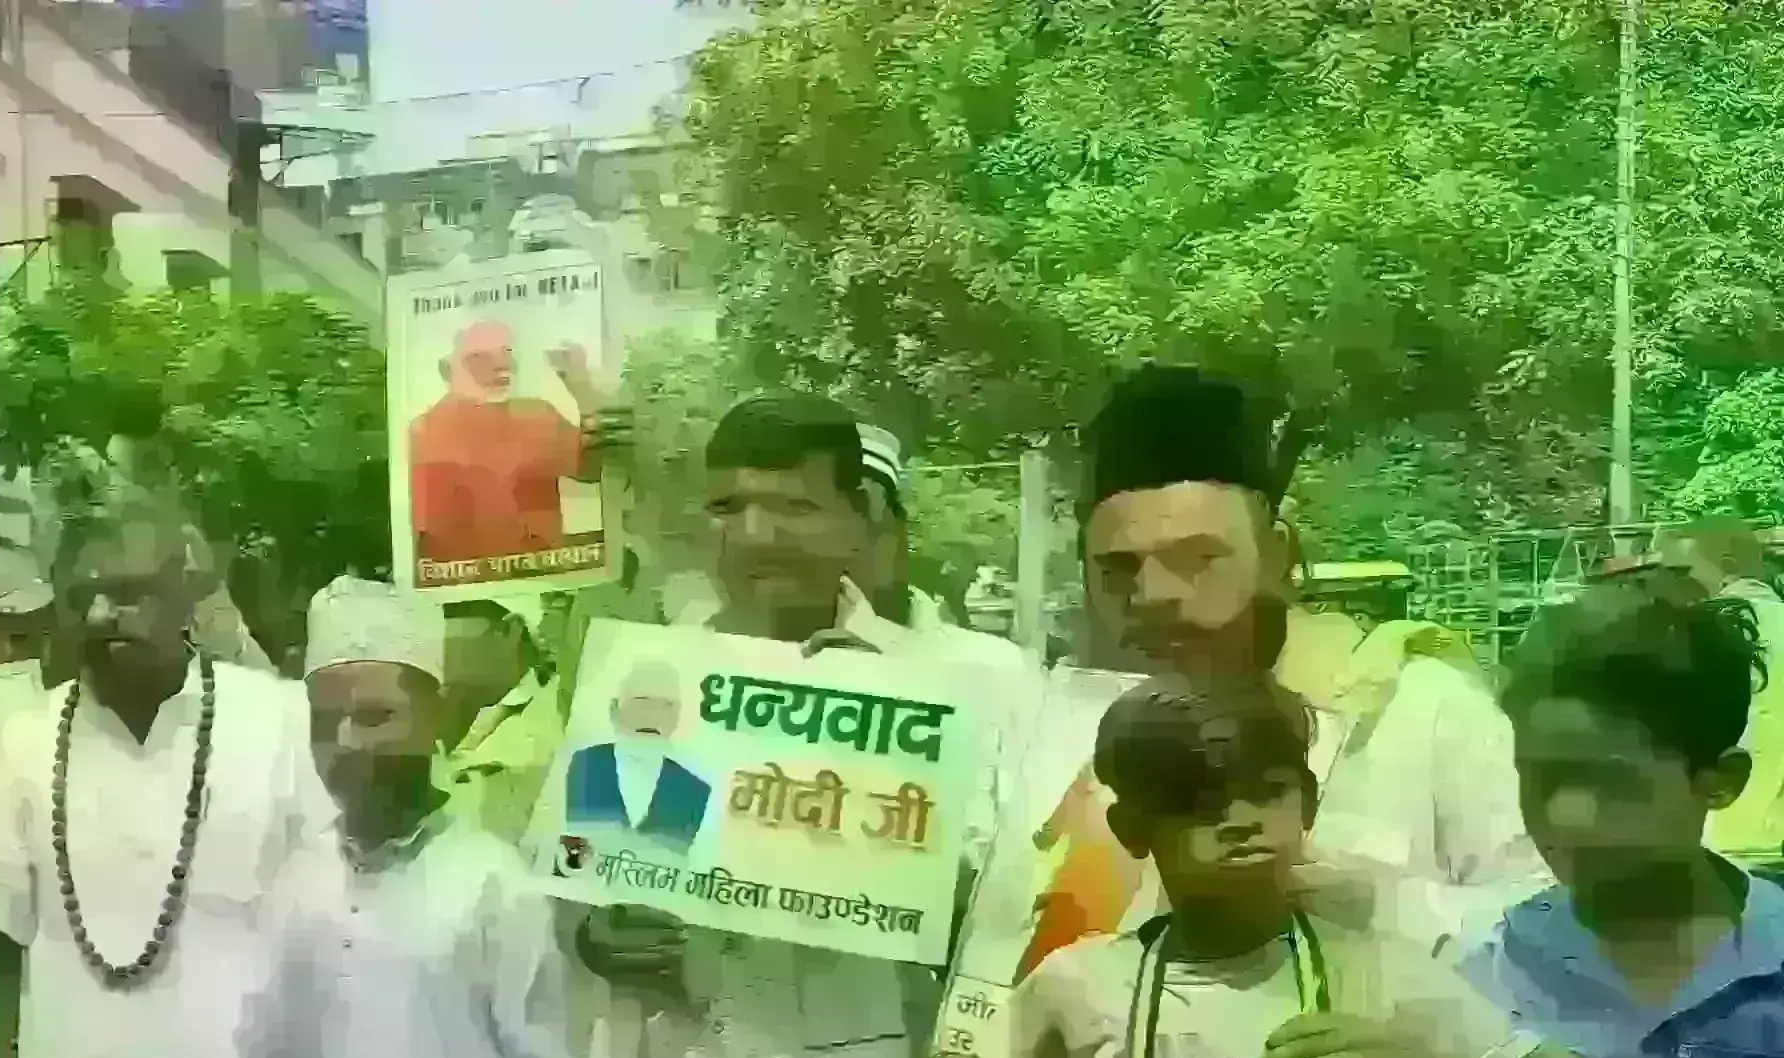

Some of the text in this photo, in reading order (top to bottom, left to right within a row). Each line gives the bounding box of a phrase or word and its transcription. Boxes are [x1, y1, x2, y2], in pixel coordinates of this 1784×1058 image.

[700, 674, 954, 762] धन्यवाद
[730, 763, 936, 852] मोदी जी
[685, 867, 772, 909] महिला
